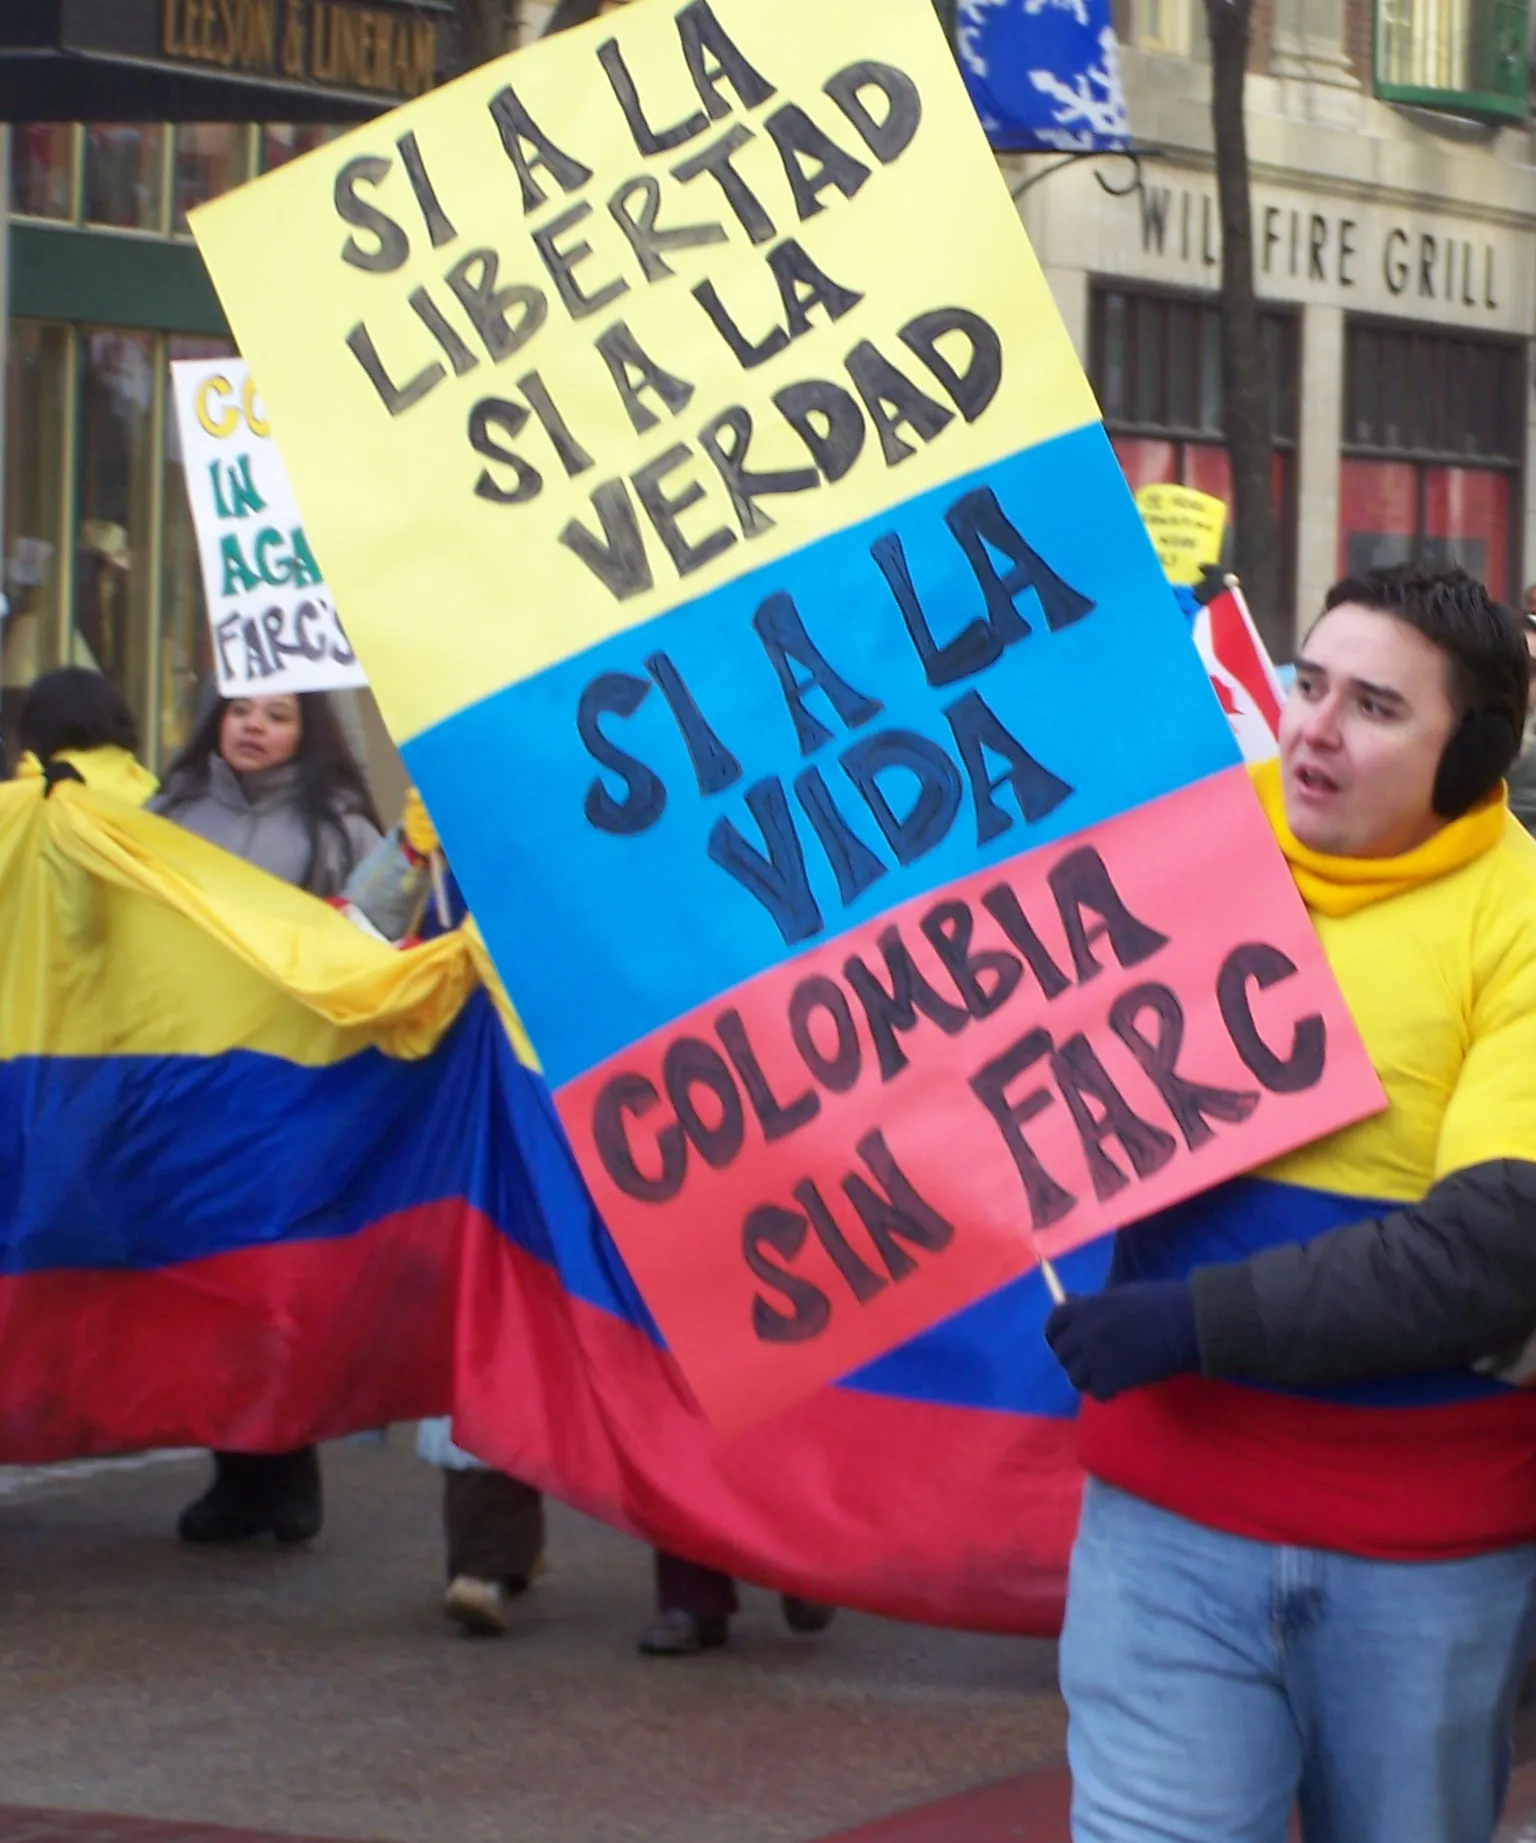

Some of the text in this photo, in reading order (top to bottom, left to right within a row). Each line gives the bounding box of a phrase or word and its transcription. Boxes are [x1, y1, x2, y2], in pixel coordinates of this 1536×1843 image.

[334, 0, 778, 274] SI A LA
[346, 60, 923, 417] LIBERTAD
[1140, 184, 1498, 310] WILFIRE GRILL
[208, 453, 267, 519] IN
[467, 237, 865, 503] SI A LA
[558, 306, 1004, 603] VERDAD
[576, 485, 1097, 837] SI A LA
[707, 688, 1075, 946] VIDA
[592, 844, 1169, 1202] COLOMBIA
[742, 943, 1326, 1344] SIN FARC
